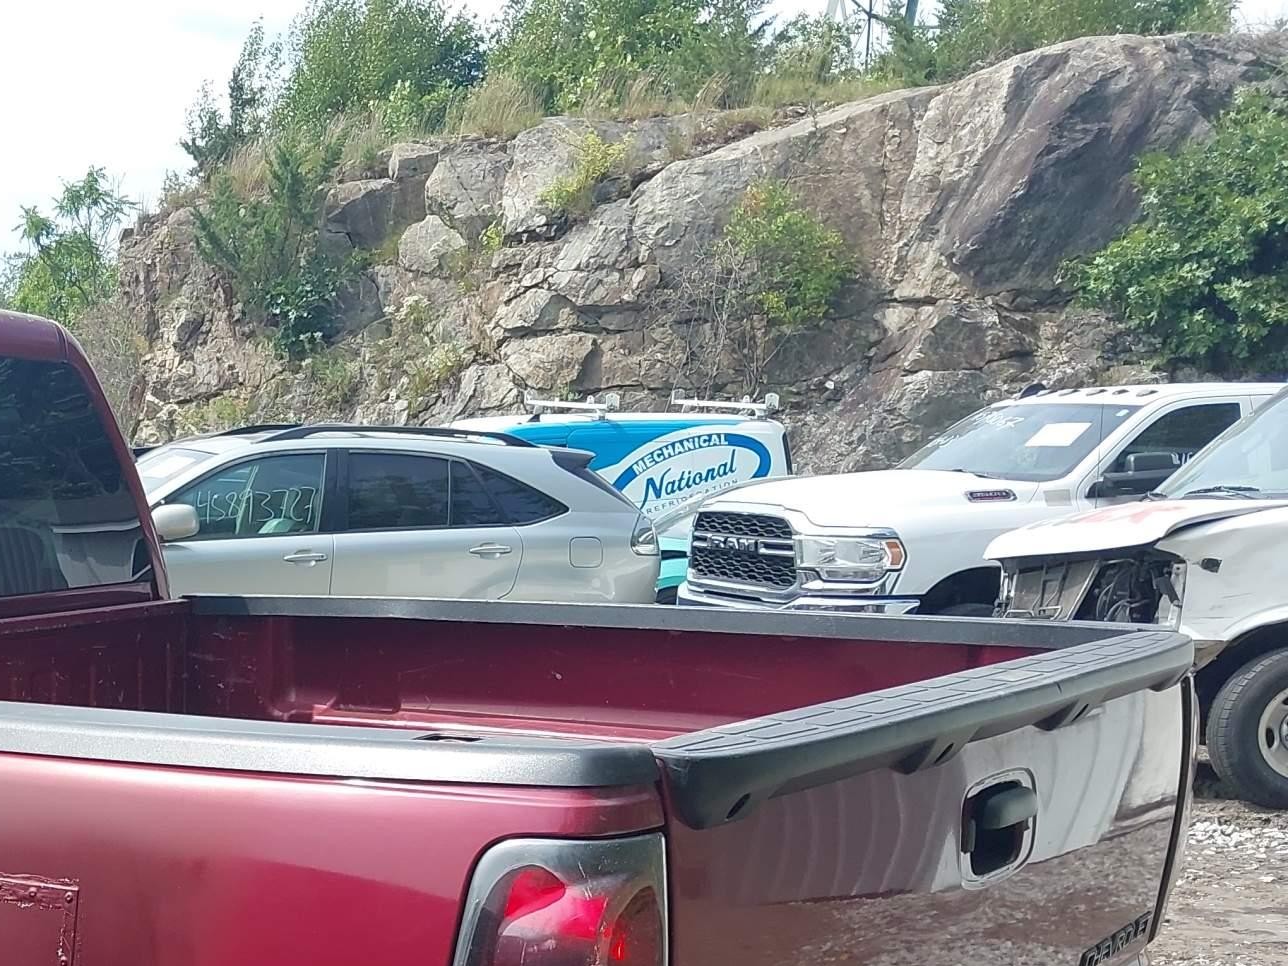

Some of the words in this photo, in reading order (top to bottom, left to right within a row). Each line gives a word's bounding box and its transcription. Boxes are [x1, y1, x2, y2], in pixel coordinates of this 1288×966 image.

[632, 434, 729, 475] MECHANICAL
[640, 449, 737, 510] National
[197, 486, 316, 524] 45893727
[711, 535, 755, 551] RAM
